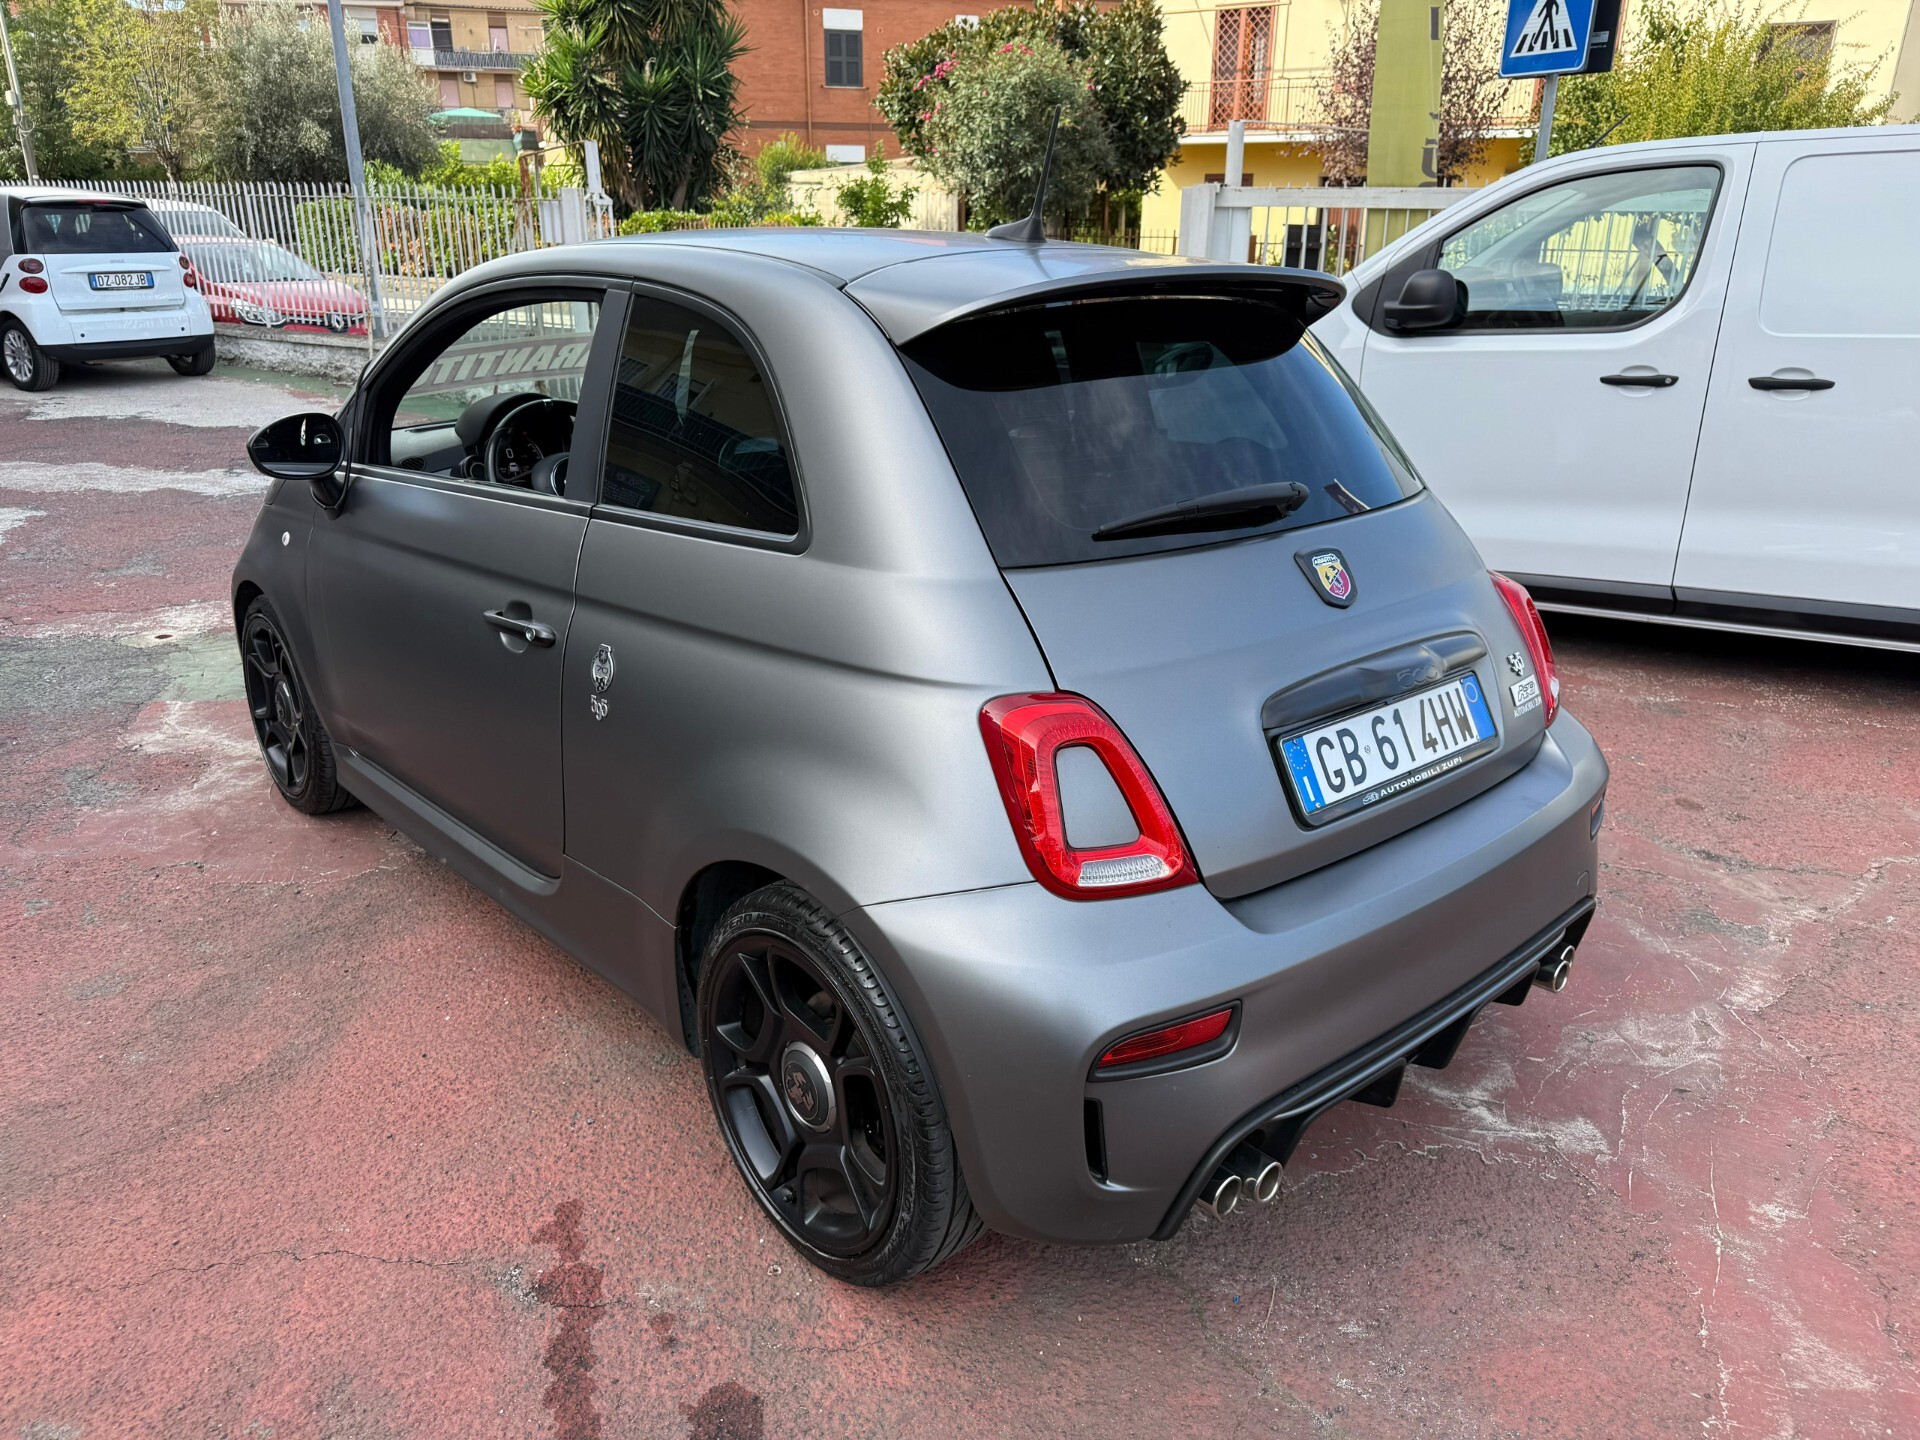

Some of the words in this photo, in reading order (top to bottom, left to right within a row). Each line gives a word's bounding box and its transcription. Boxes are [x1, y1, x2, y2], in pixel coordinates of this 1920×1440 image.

[591, 694, 608, 721] 595
[1315, 727, 1368, 794] GB
[1380, 767, 1440, 797] AUTOMOBILI
[1441, 756, 1463, 770] ZUPI
